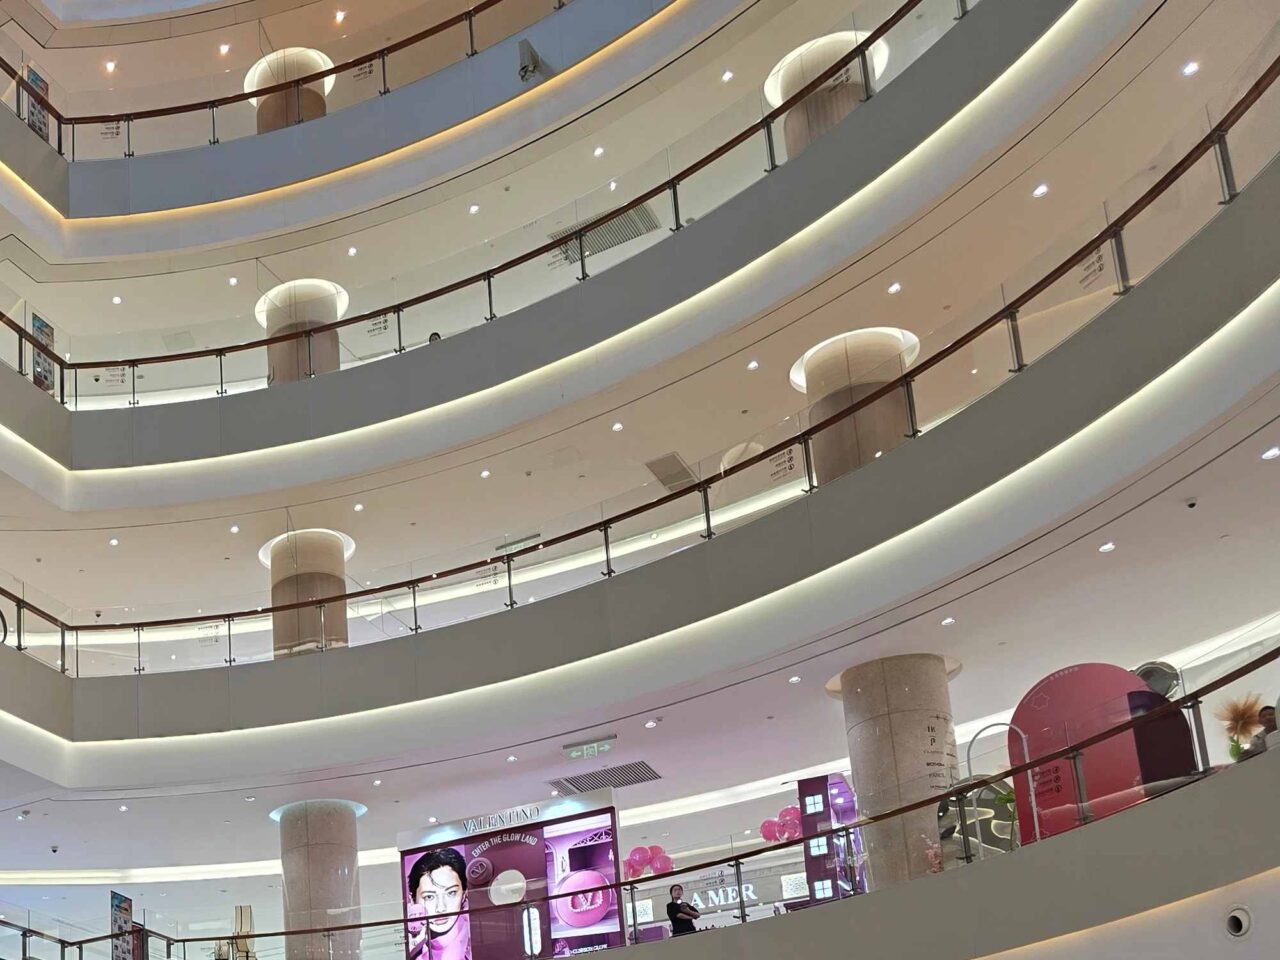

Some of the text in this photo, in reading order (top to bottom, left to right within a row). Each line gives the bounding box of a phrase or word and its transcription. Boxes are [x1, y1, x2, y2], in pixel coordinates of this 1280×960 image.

[463, 805, 541, 833] VALENTINO
[471, 832, 538, 858] ENTER THE GLOW LAND
